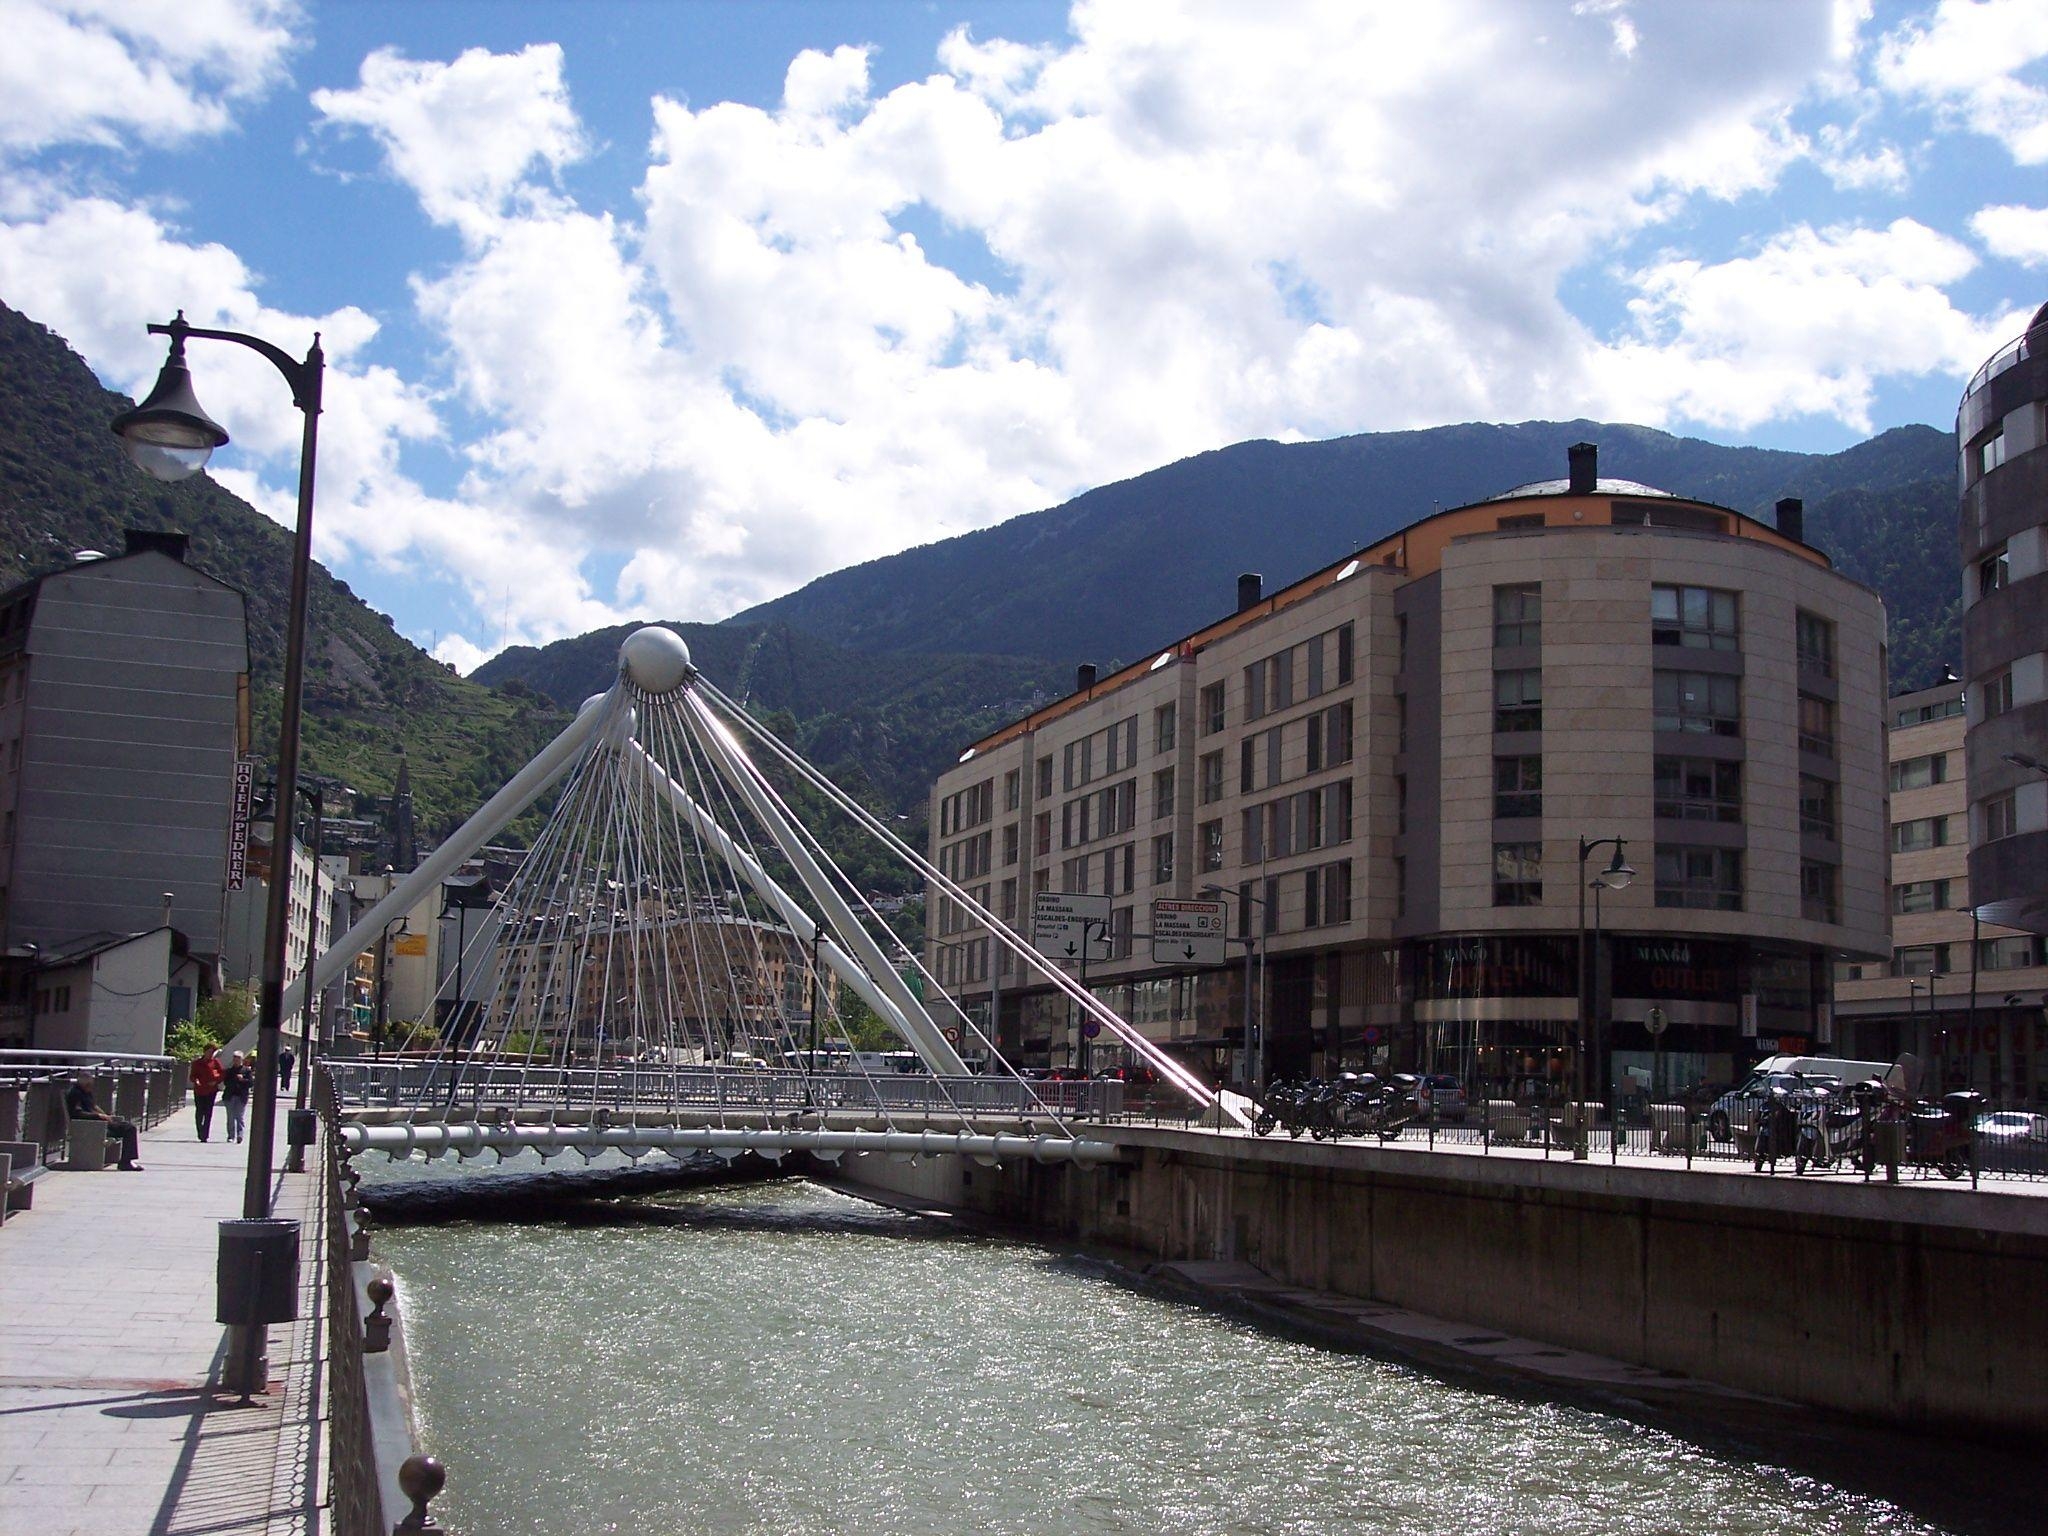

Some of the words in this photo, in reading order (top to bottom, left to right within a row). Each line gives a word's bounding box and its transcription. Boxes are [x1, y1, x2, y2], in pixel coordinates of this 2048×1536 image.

[237, 765, 250, 812] HOTEL
[230, 822, 246, 889] PEDRERA
[1443, 947, 1488, 961] MANGO
[1638, 947, 1690, 962] MANGO
[1452, 964, 1525, 988] OUTLET
[1651, 967, 1720, 991] OUTLET
[1756, 1038, 1779, 1052] MANGO
